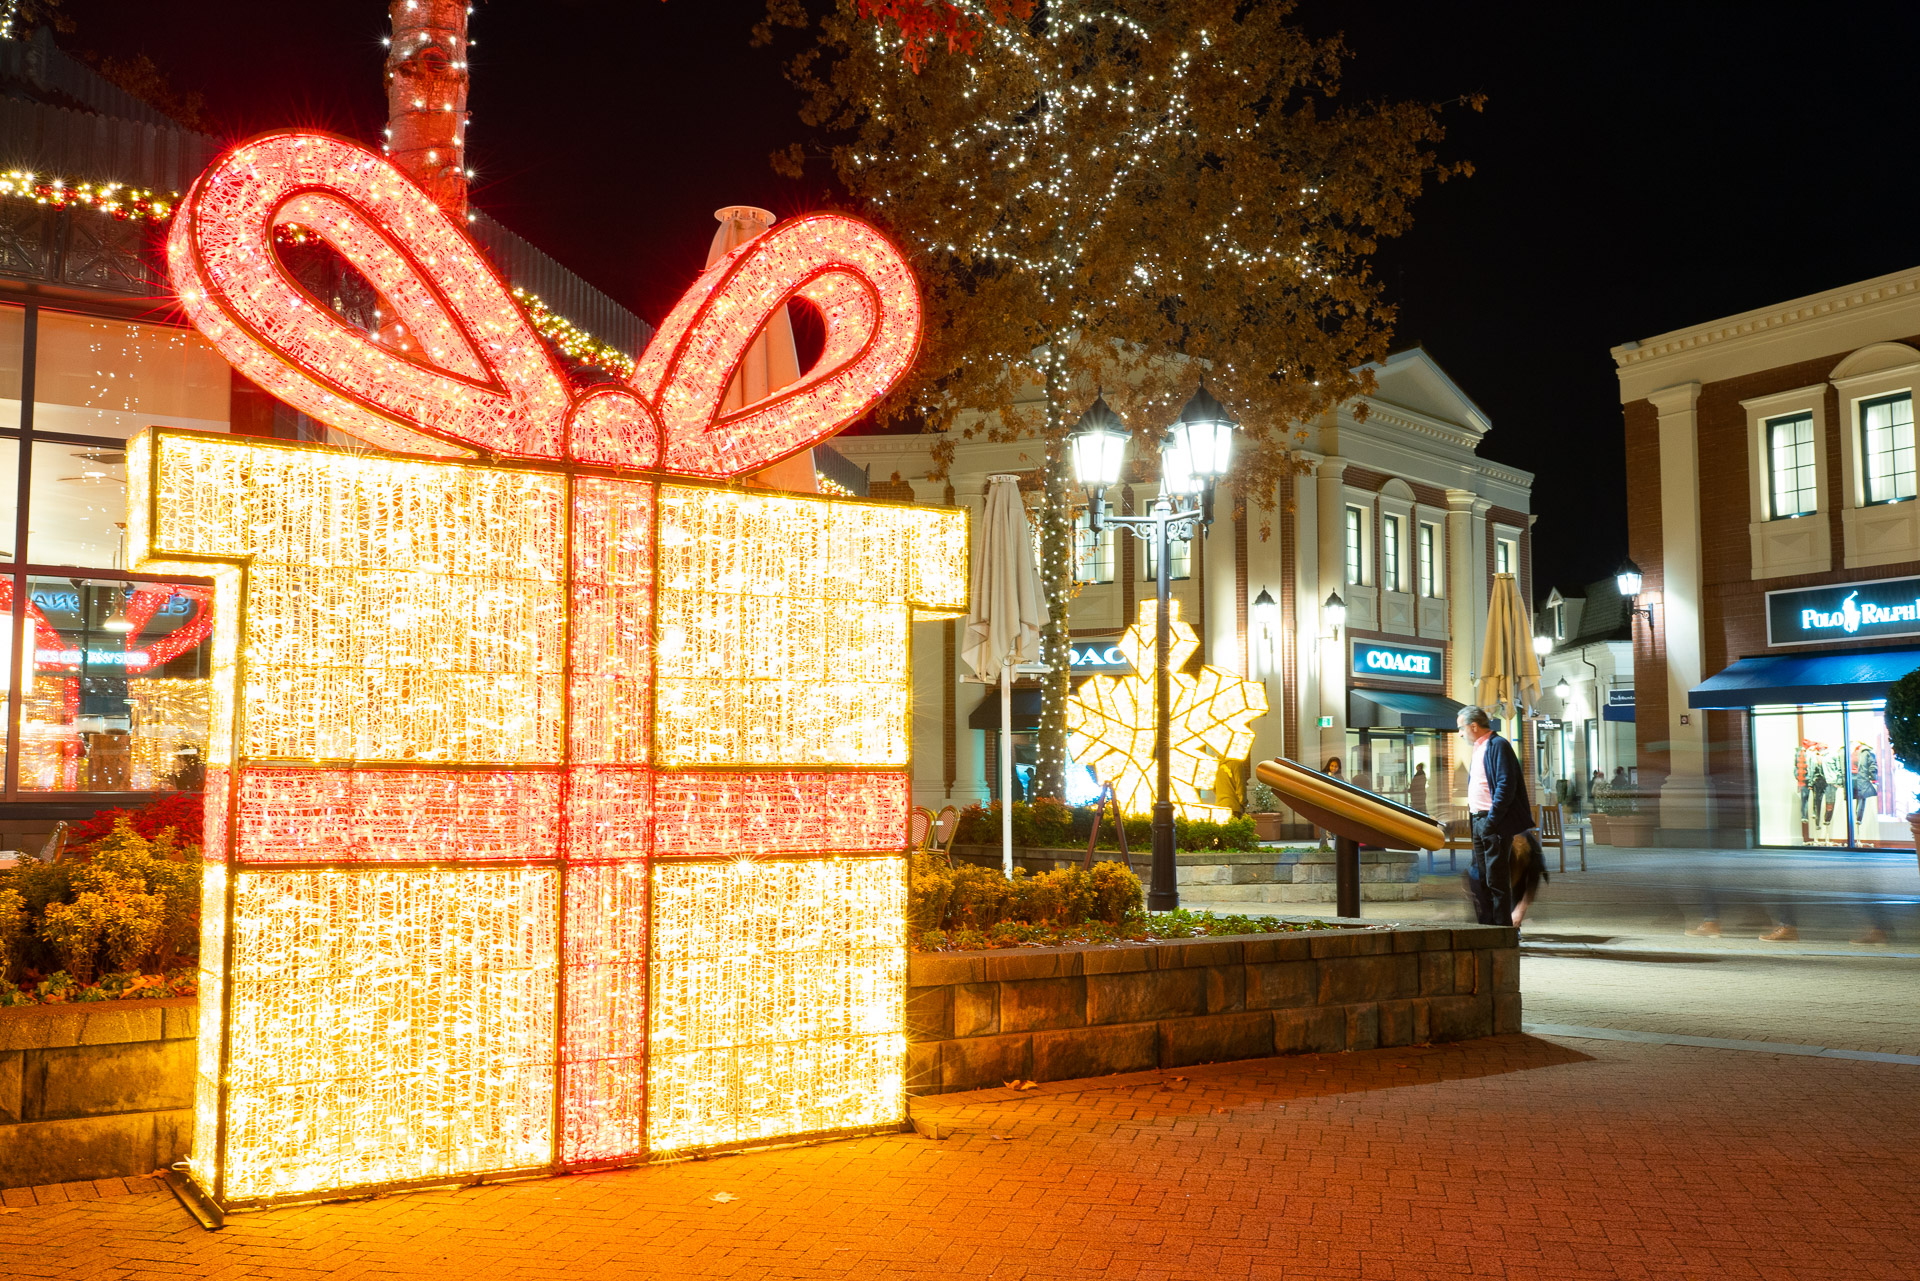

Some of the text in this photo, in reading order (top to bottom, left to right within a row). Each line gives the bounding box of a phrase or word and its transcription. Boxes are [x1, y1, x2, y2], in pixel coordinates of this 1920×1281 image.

[1802, 609, 1844, 629] POLO
[1861, 603, 1915, 624] RALPH
[1366, 650, 1431, 673] COACH
